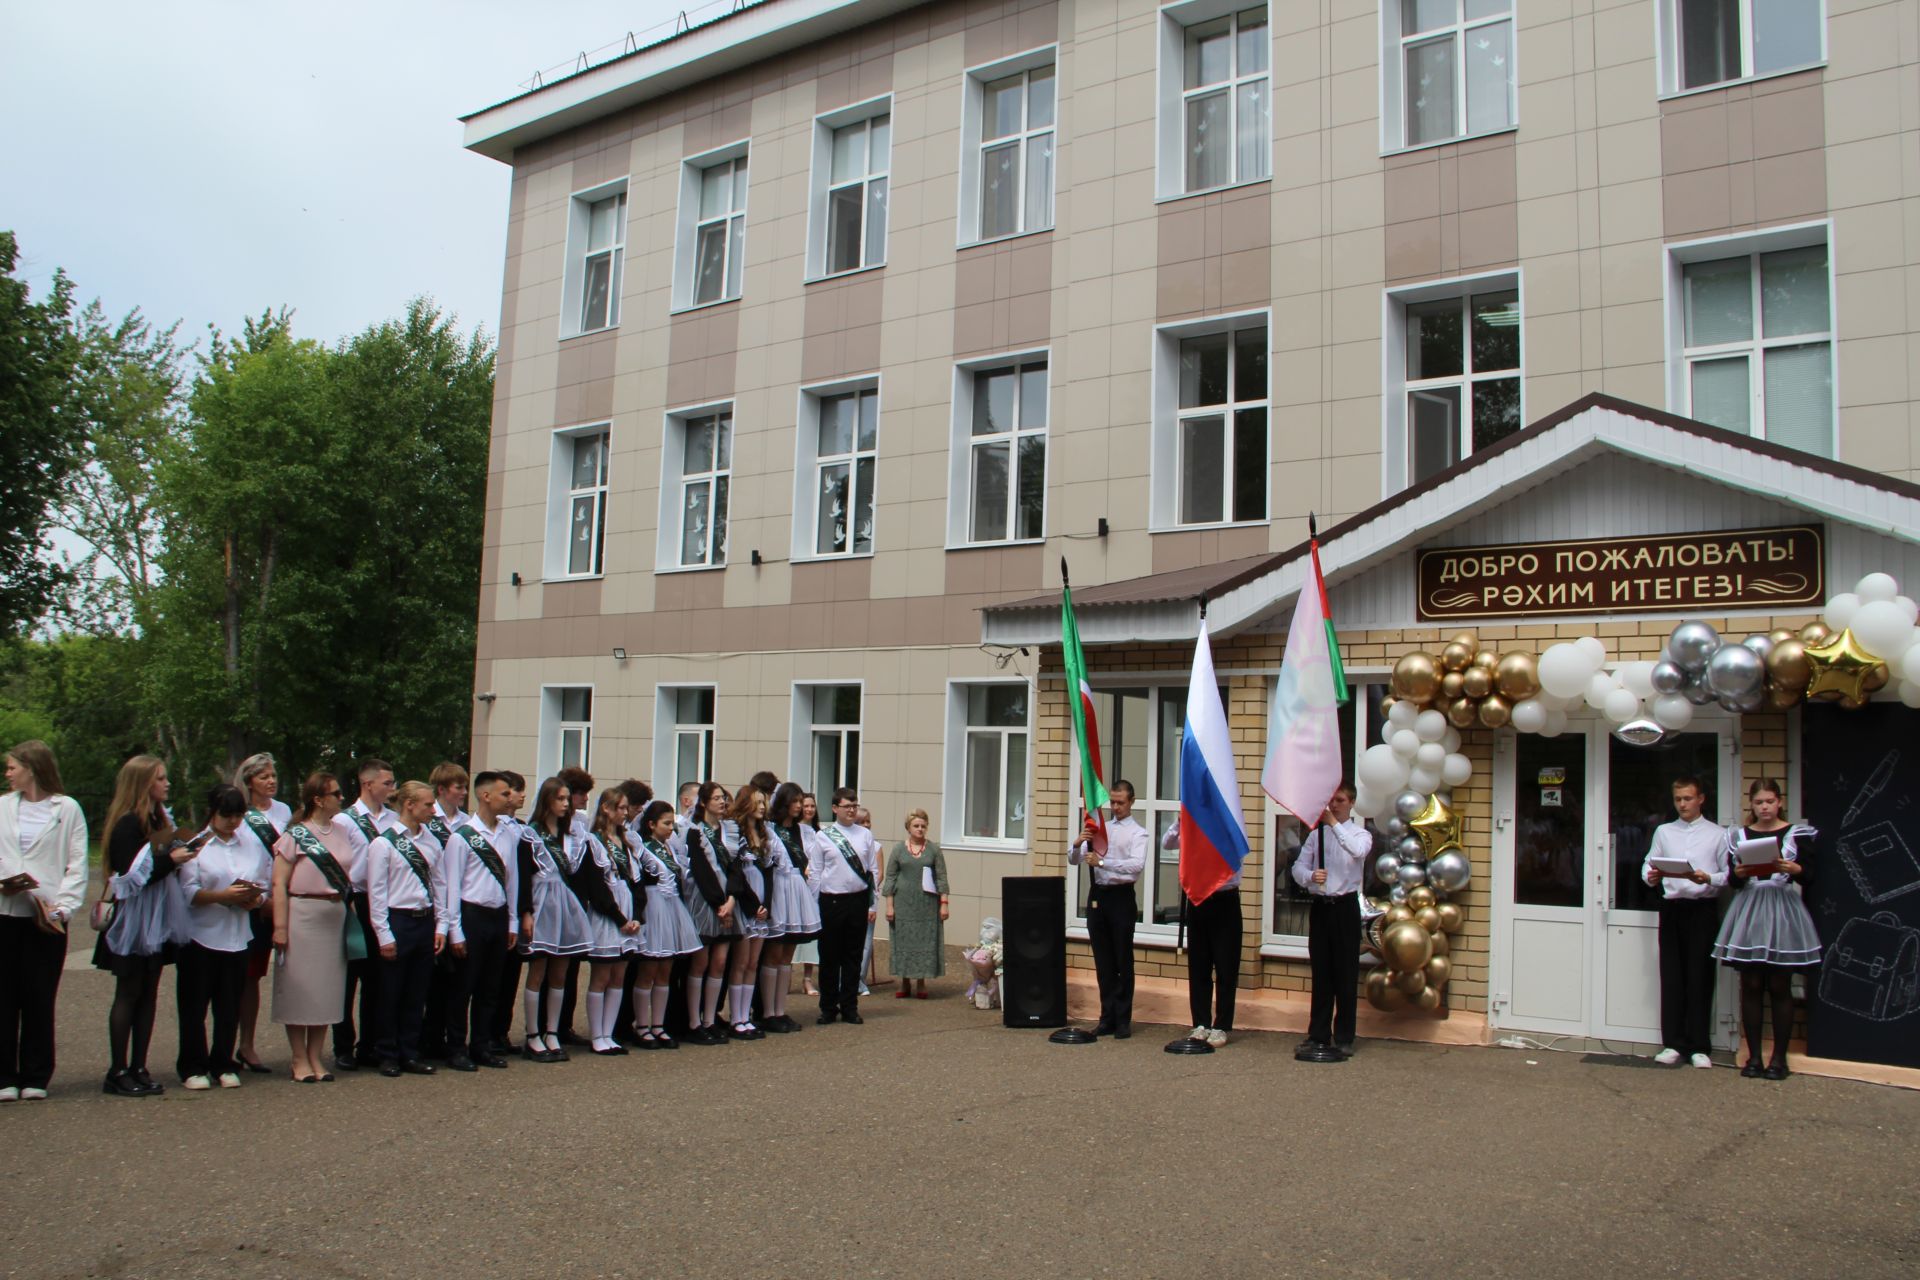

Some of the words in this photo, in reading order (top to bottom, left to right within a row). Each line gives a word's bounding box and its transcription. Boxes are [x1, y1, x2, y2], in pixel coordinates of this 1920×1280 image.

[1440, 553, 1539, 583] ДОБРО
[1556, 538, 1794, 573] ПОЖАЛОВАТЬ!
[1483, 581, 1594, 607] РӘХИМ
[1611, 574, 1743, 602] ИТЕГЕЗ!
